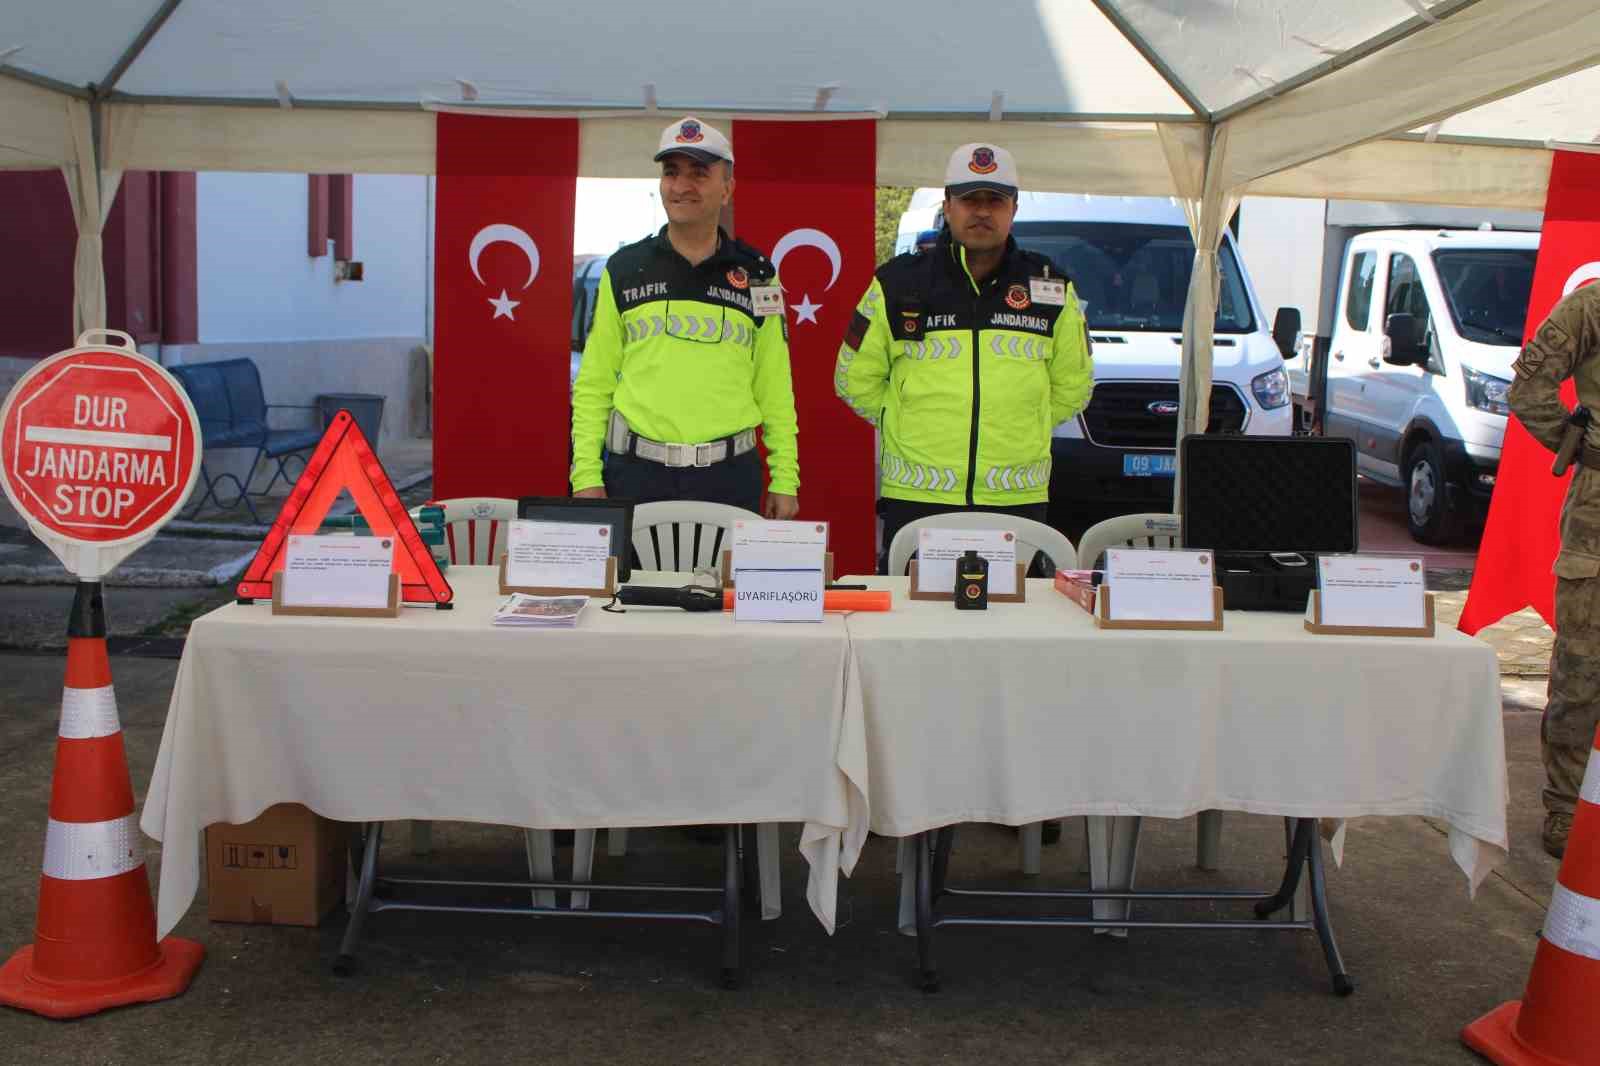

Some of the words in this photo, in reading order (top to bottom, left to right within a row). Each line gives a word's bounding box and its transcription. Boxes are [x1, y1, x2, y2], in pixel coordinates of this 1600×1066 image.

[990, 312, 1049, 331] JANDARMASI
[73, 394, 128, 429] DUR
[25, 446, 167, 486] JANDARMA
[1132, 455, 1149, 472] 09
[53, 484, 135, 518] STOP
